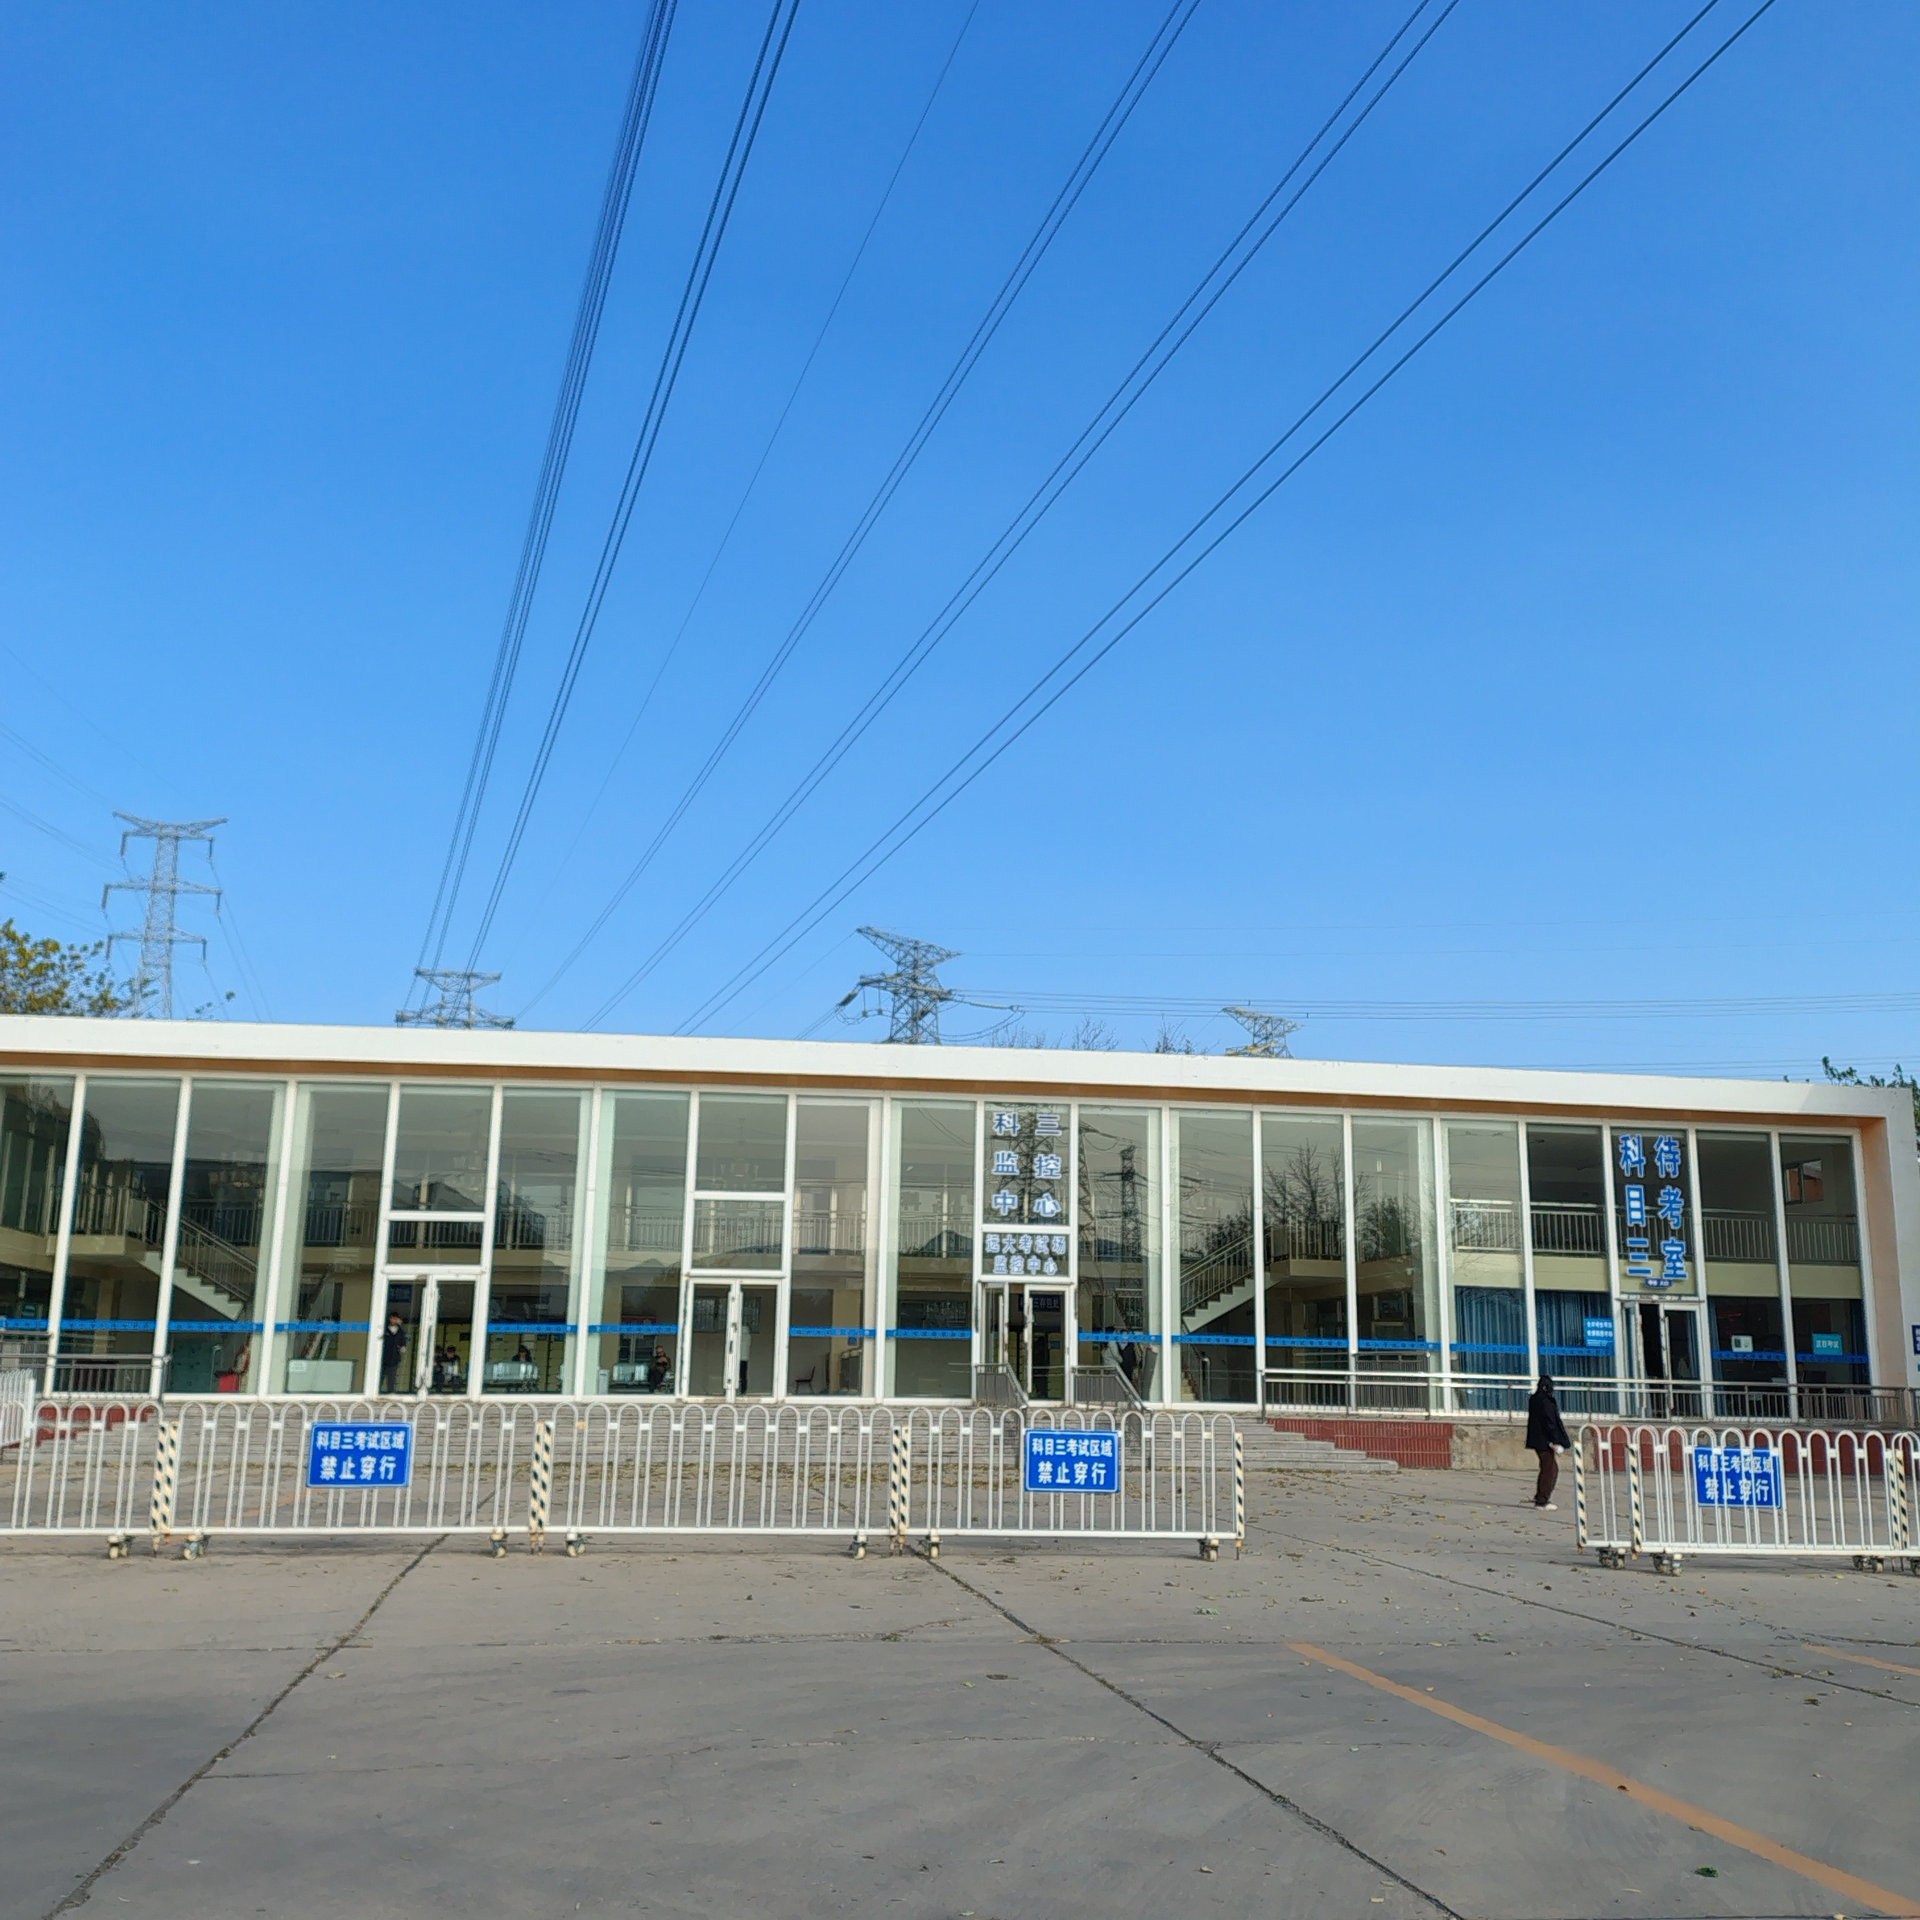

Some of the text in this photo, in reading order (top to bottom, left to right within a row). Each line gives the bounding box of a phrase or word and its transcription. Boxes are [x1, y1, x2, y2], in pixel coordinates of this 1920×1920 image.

[993, 1112, 1062, 1136] 科三
[992, 1151, 1062, 1179] 监控
[992, 1189, 1062, 1217] 中心
[1619, 1133, 1652, 1277] 科目三
[1653, 1134, 1688, 1280] 待考室
[993, 1255, 1058, 1275] 监控中心
[316, 1431, 405, 1450] 科目三考试区域
[1032, 1437, 1112, 1457] 科目三考试区域
[320, 1455, 396, 1480] 禁止穿行
[1038, 1461, 1106, 1485] 禁止穿行
